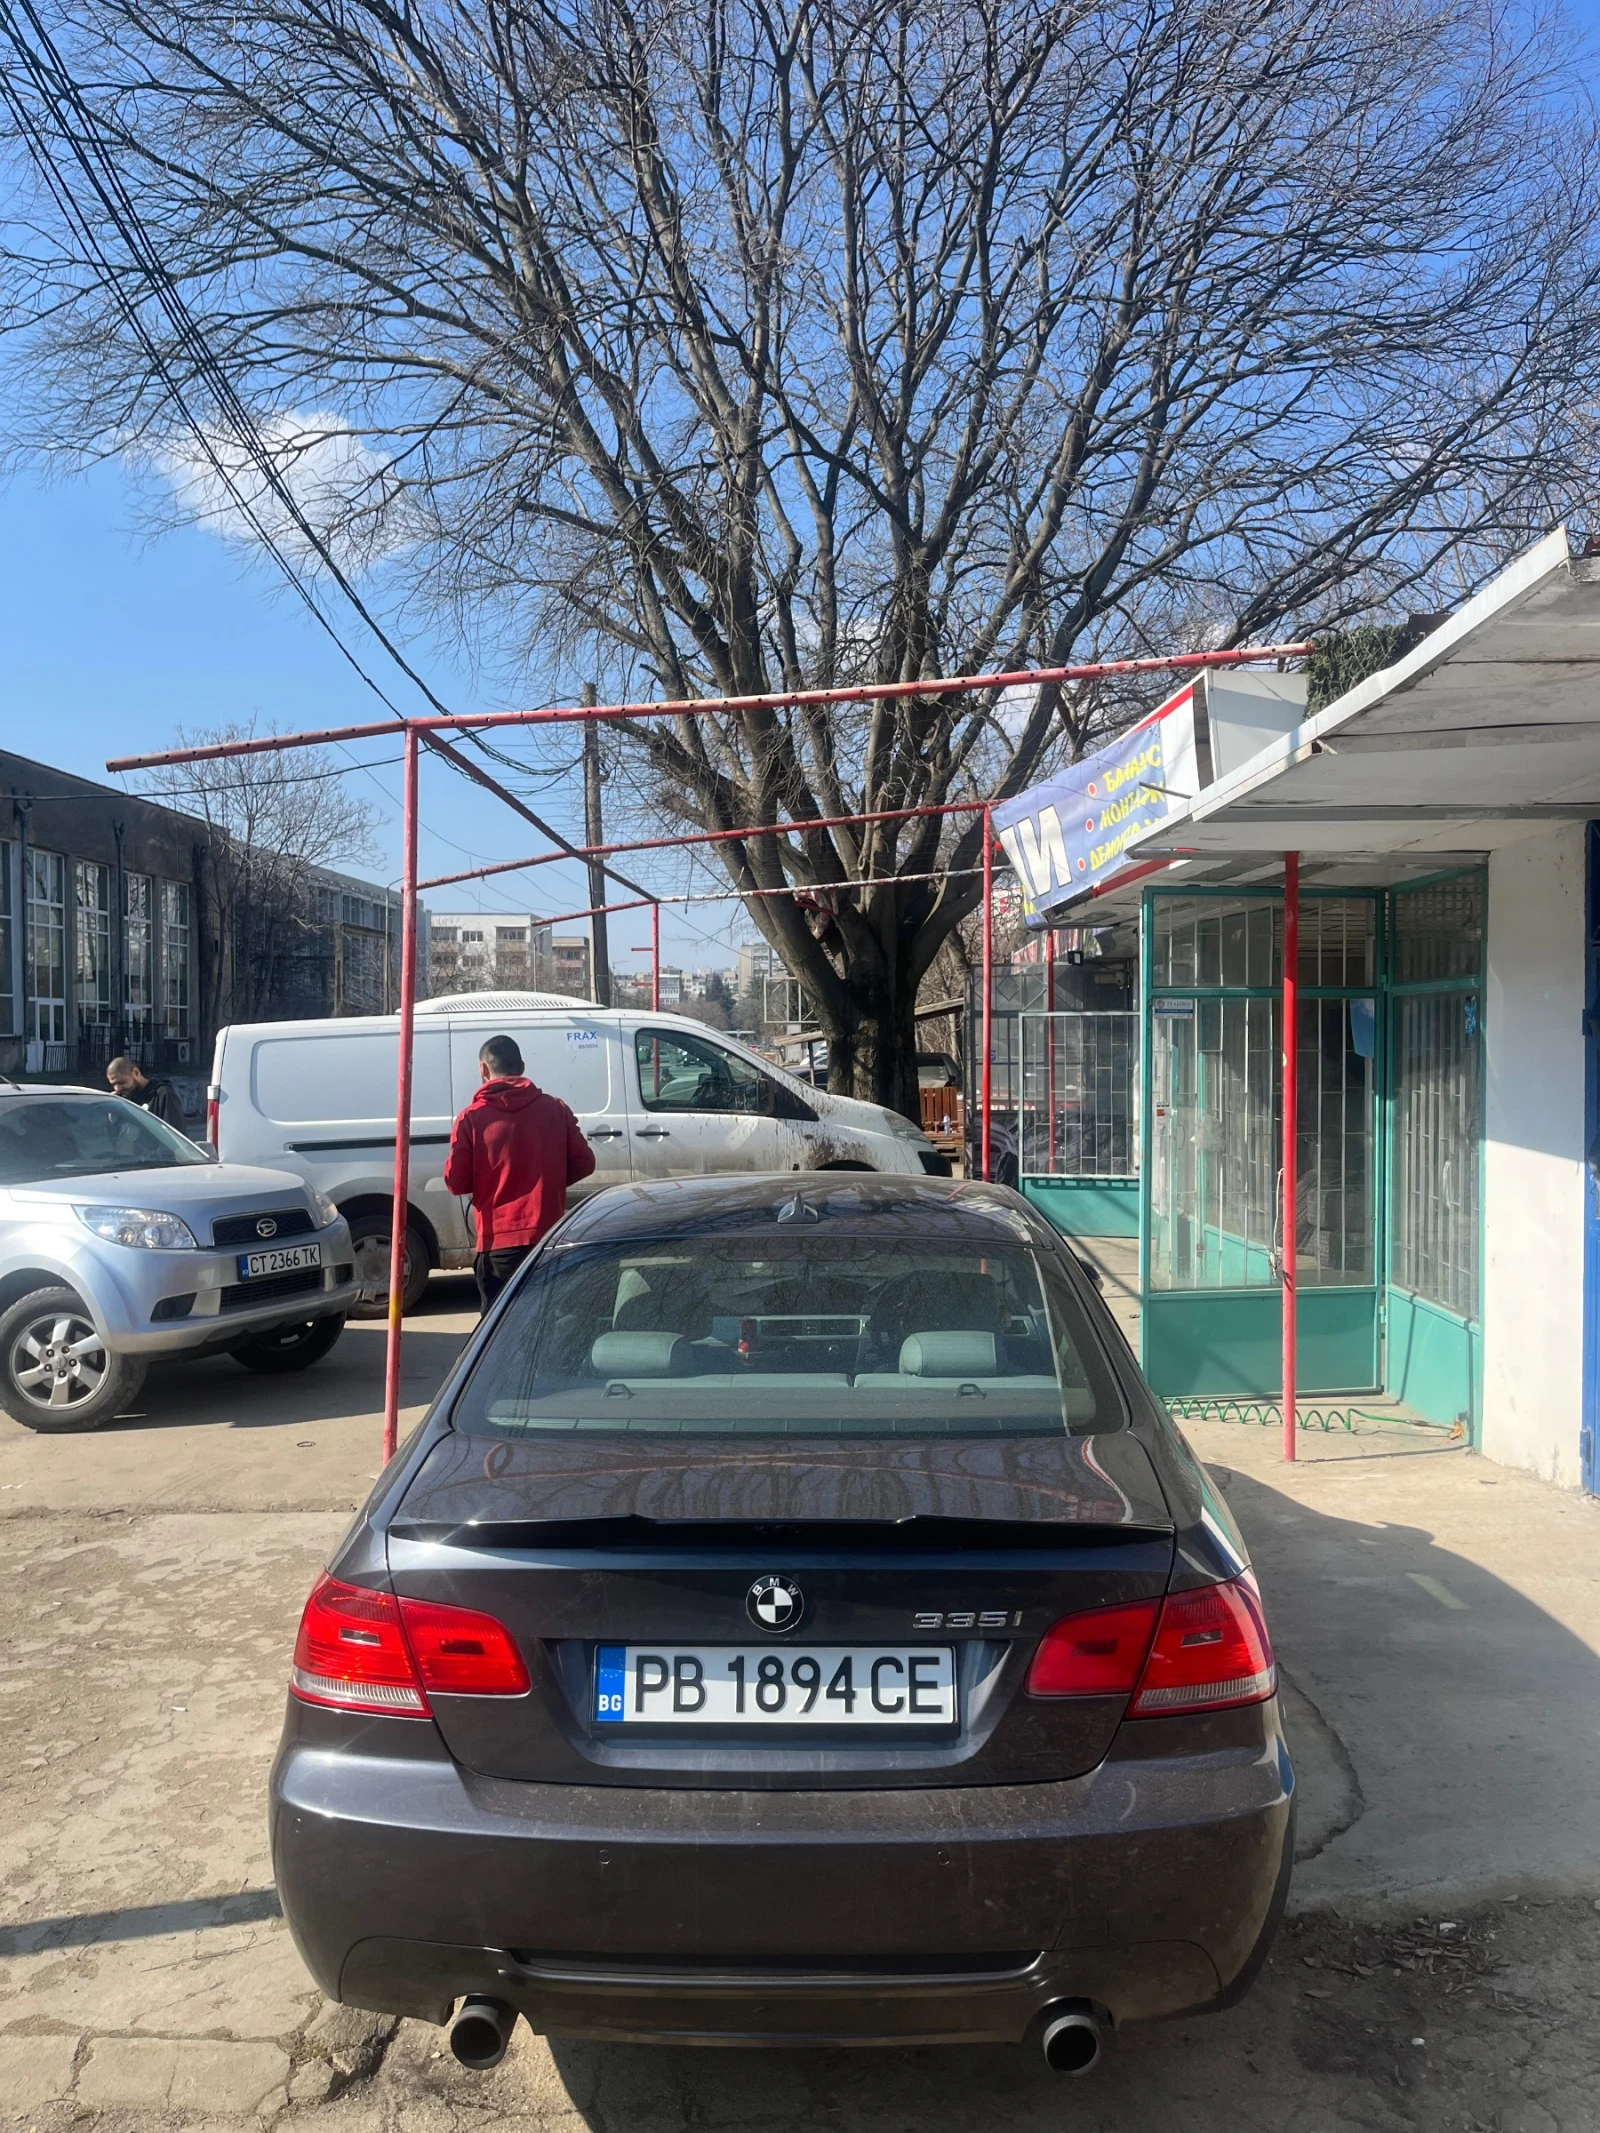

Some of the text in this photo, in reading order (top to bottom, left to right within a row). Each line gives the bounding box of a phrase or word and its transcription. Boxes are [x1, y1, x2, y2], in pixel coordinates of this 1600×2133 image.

[1102, 744, 1161, 793] БАЛАНС
[1099, 780, 1166, 831] МОНТАЖ
[566, 1031, 597, 1041] FRAX
[250, 1247, 318, 1274] CT 2366 TK
[752, 1577, 799, 1597] BMW
[635, 1655, 943, 1714] PB 1894 CE
[599, 1694, 622, 1712] BG
